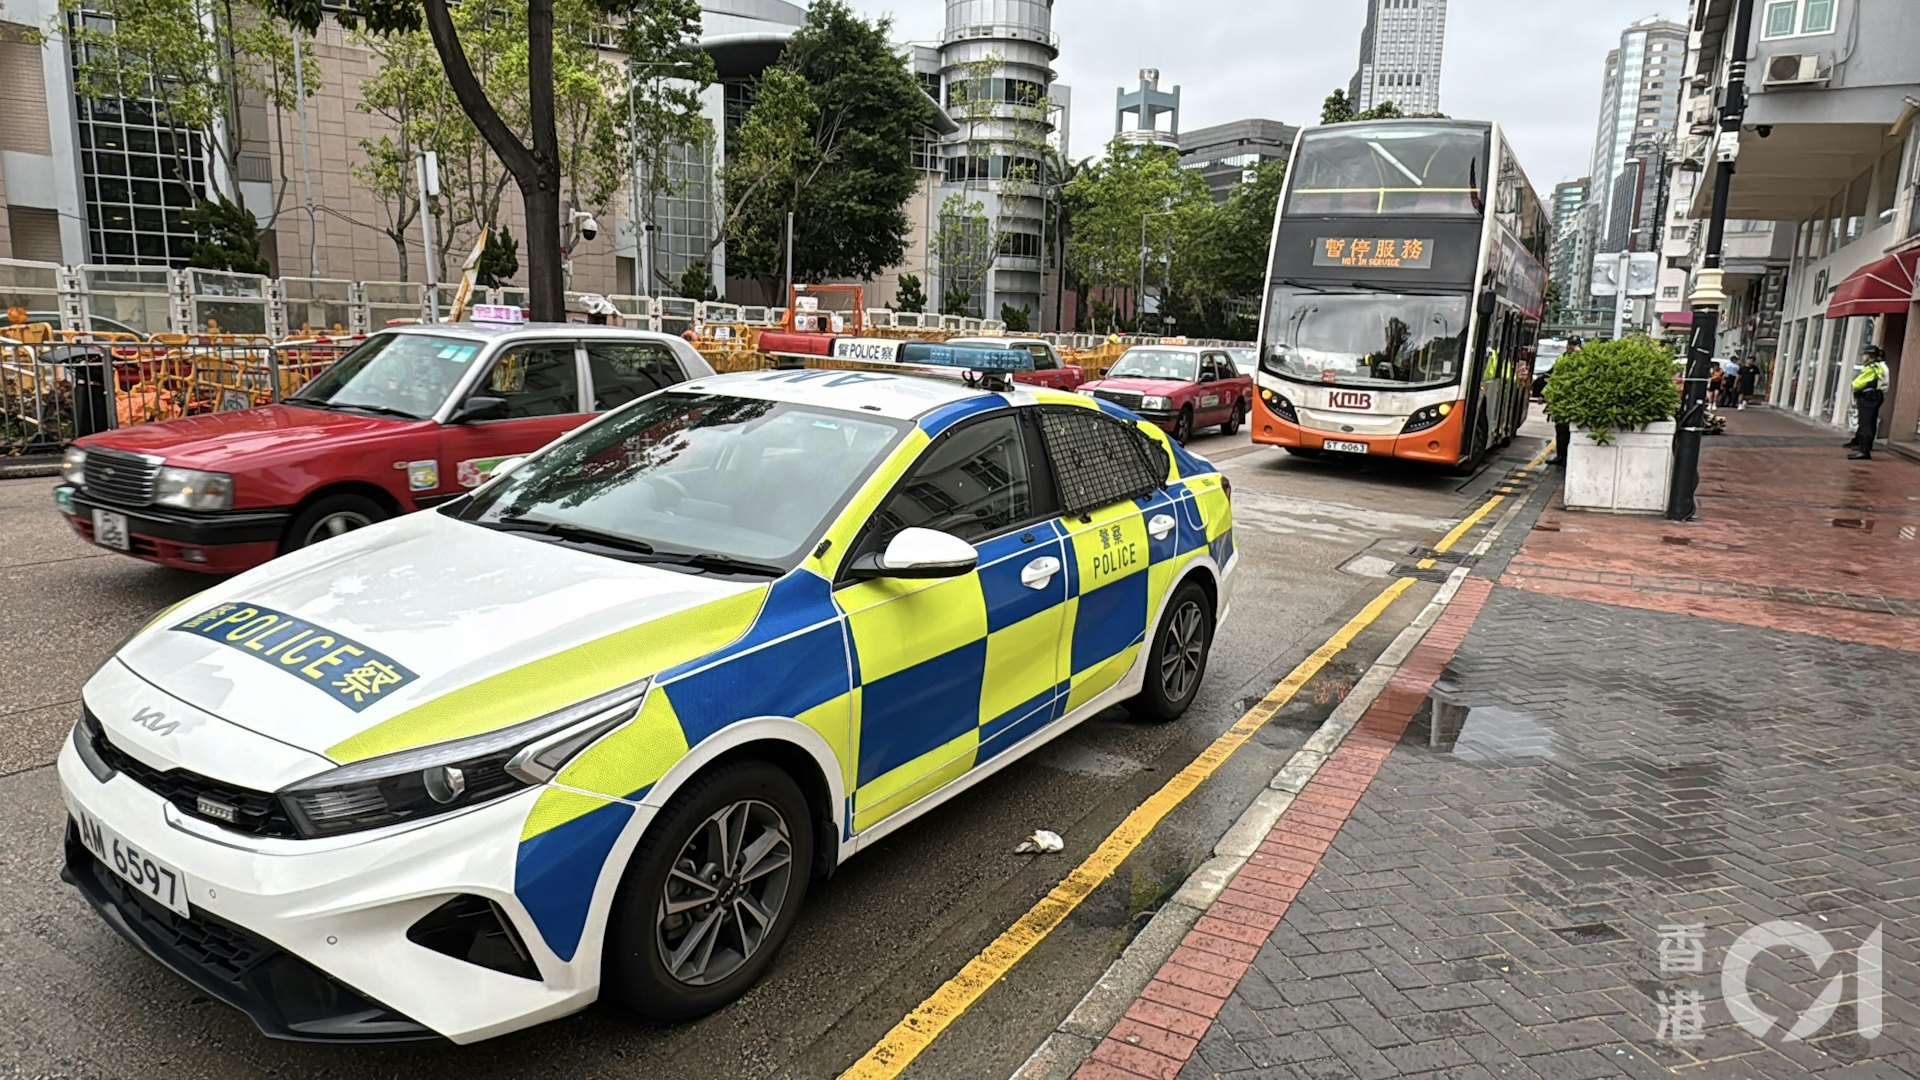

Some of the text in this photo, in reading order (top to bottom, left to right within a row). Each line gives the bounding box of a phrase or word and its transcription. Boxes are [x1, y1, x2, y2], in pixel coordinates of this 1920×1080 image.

[1325, 238, 1422, 259] 暫停服務
[1341, 257, 1401, 267] NOT IN SERVICE
[849, 343, 880, 360] POLICE
[1328, 391, 1372, 410] KMB
[1326, 441, 1366, 453] ST 6063
[1098, 524, 1123, 550] 警察
[1093, 543, 1137, 579] POLICE
[202, 607, 365, 679] POLICE
[331, 659, 403, 702] 察
[132, 707, 180, 736] KIA
[80, 811, 177, 905] AM 6597
